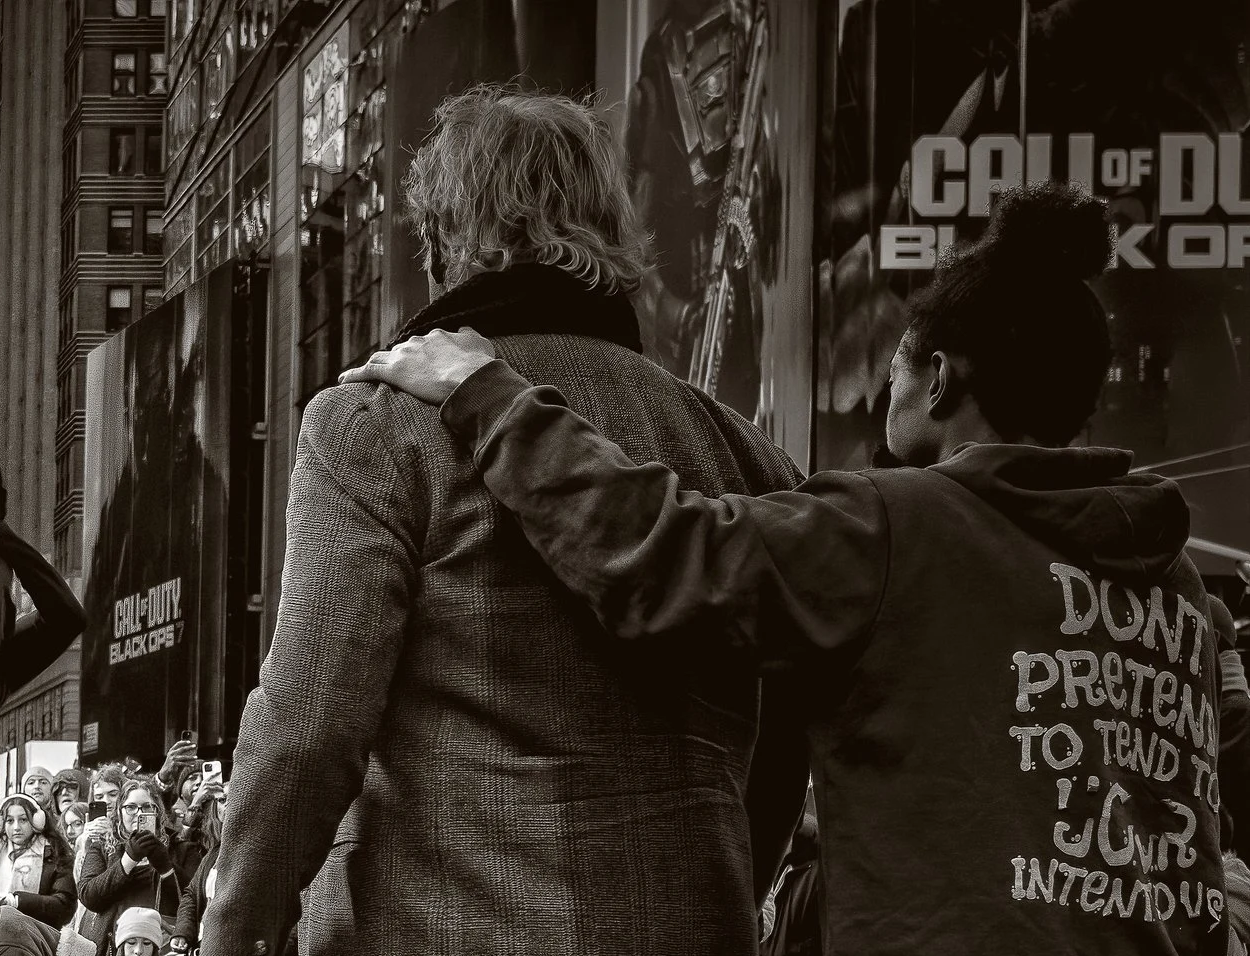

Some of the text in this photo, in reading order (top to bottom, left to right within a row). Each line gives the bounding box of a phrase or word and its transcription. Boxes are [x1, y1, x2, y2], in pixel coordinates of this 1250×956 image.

[911, 133, 1094, 217] CALL
[1102, 149, 1154, 186] OF
[880, 224, 1156, 269] BLK
[114, 592, 142, 639] CALL
[148, 577, 181, 629] DUTY
[109, 620, 185, 665] BLACK OPS 7
[1008, 722, 1084, 771] TO
